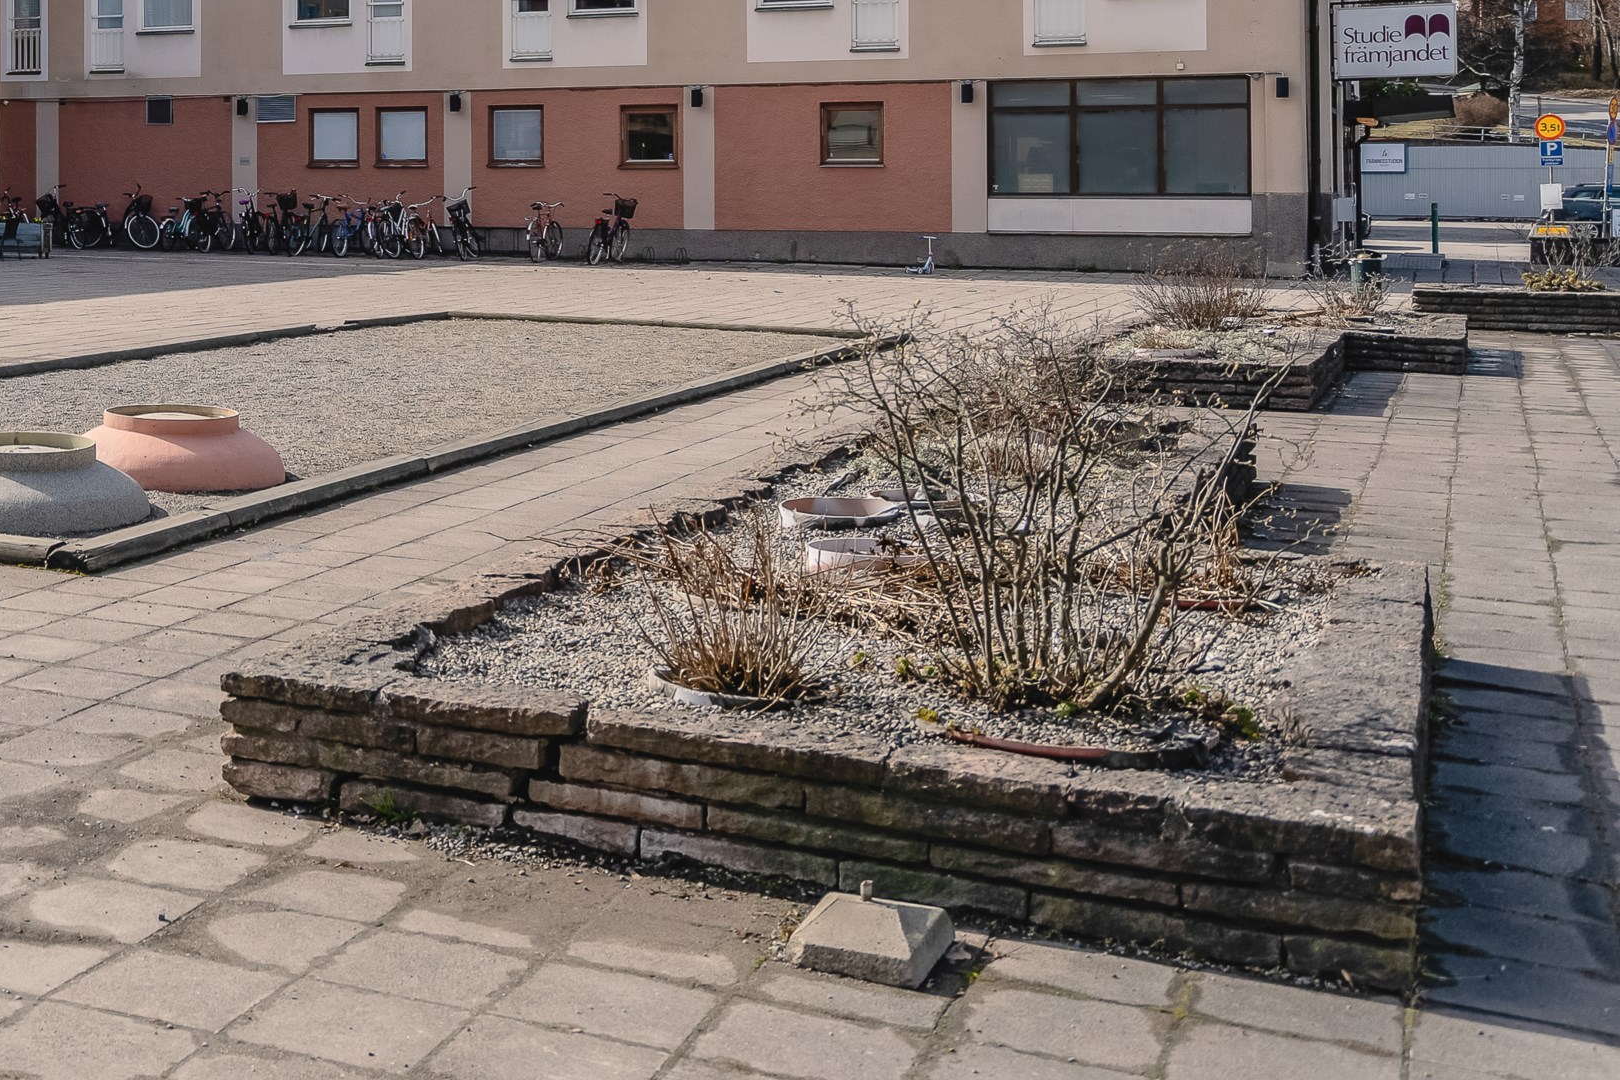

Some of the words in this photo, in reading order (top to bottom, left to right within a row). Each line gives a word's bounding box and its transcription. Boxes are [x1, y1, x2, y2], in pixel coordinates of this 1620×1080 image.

[1343, 25, 1402, 45] Studie
[1343, 43, 1450, 68] främjandet
[1546, 142, 1558, 156] P
